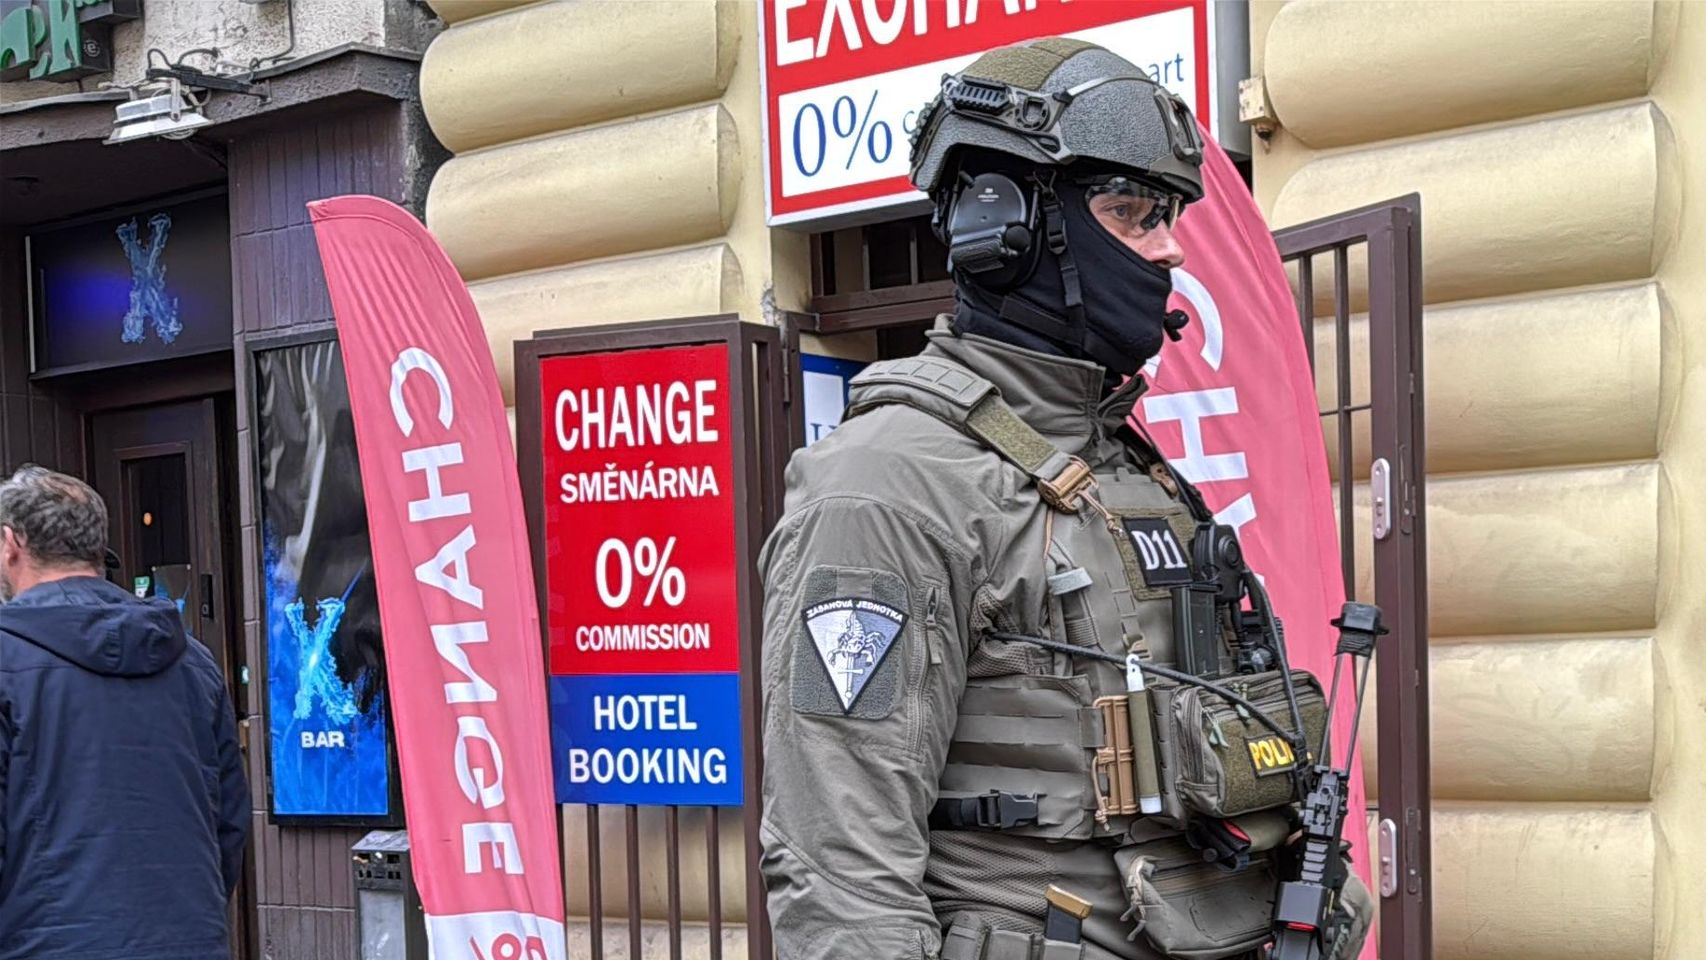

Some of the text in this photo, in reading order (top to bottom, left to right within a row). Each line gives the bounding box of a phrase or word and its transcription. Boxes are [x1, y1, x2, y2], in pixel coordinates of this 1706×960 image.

[792, 88, 893, 178] 0%
[555, 379, 719, 451] CHANGE
[560, 461, 720, 503] SMĚNÁRNA
[1131, 528, 1188, 571] D11
[595, 535, 687, 609] 0%
[856, 600, 904, 623] JEDNOTKA
[576, 623, 710, 652] COMMISSION
[593, 695, 698, 732] HOTEL
[301, 731, 345, 748] BAR
[569, 747, 728, 785] BOOKING
